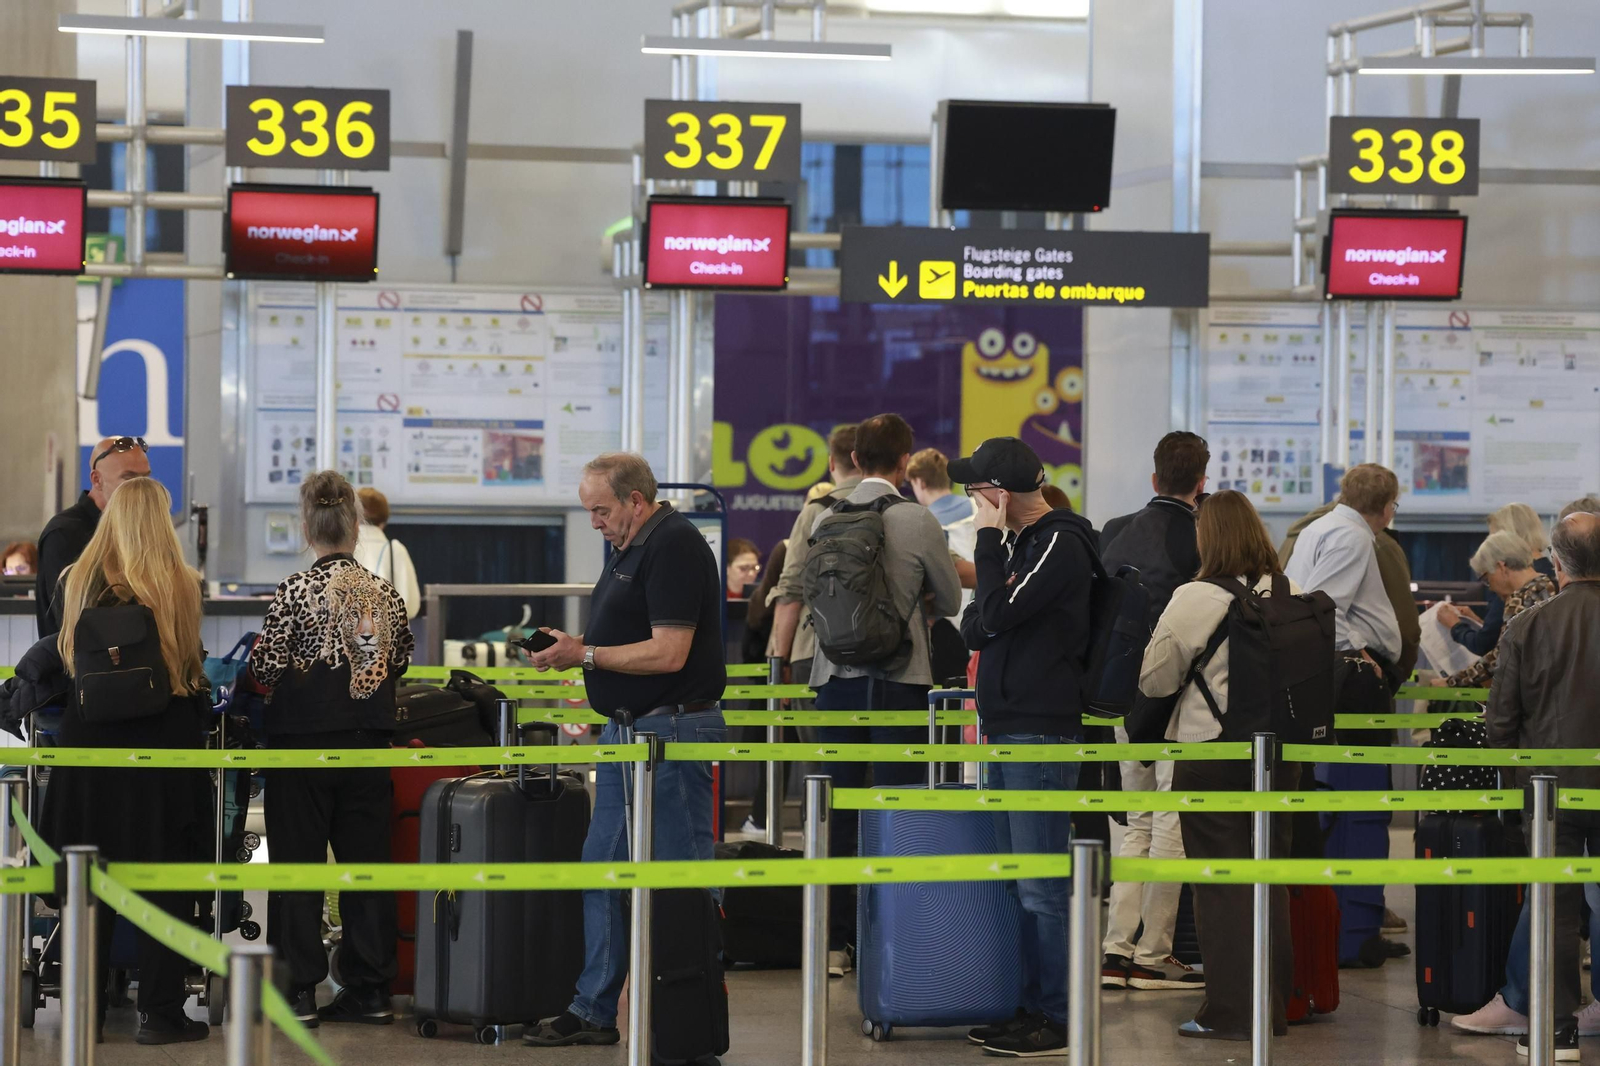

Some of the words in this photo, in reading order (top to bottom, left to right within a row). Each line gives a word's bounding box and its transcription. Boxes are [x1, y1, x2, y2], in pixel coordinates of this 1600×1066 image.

[247, 98, 375, 159] 336
[664, 112, 787, 171] 337
[1348, 128, 1466, 185] 338
[247, 224, 340, 243] norwegian
[663, 234, 753, 254] norwegian
[963, 245, 1031, 265] Flugsteige
[1034, 246, 1074, 263] Gates
[1345, 246, 1430, 265] norwegian
[689, 261, 743, 275] Check-in
[963, 262, 1023, 282] Boarding
[1025, 264, 1064, 282] gates
[1368, 272, 1420, 285] Check-in
[963, 280, 1029, 299] Puertas
[1033, 281, 1055, 299] de
[1059, 282, 1146, 304] embarque
[1314, 728, 1325, 737] HH
